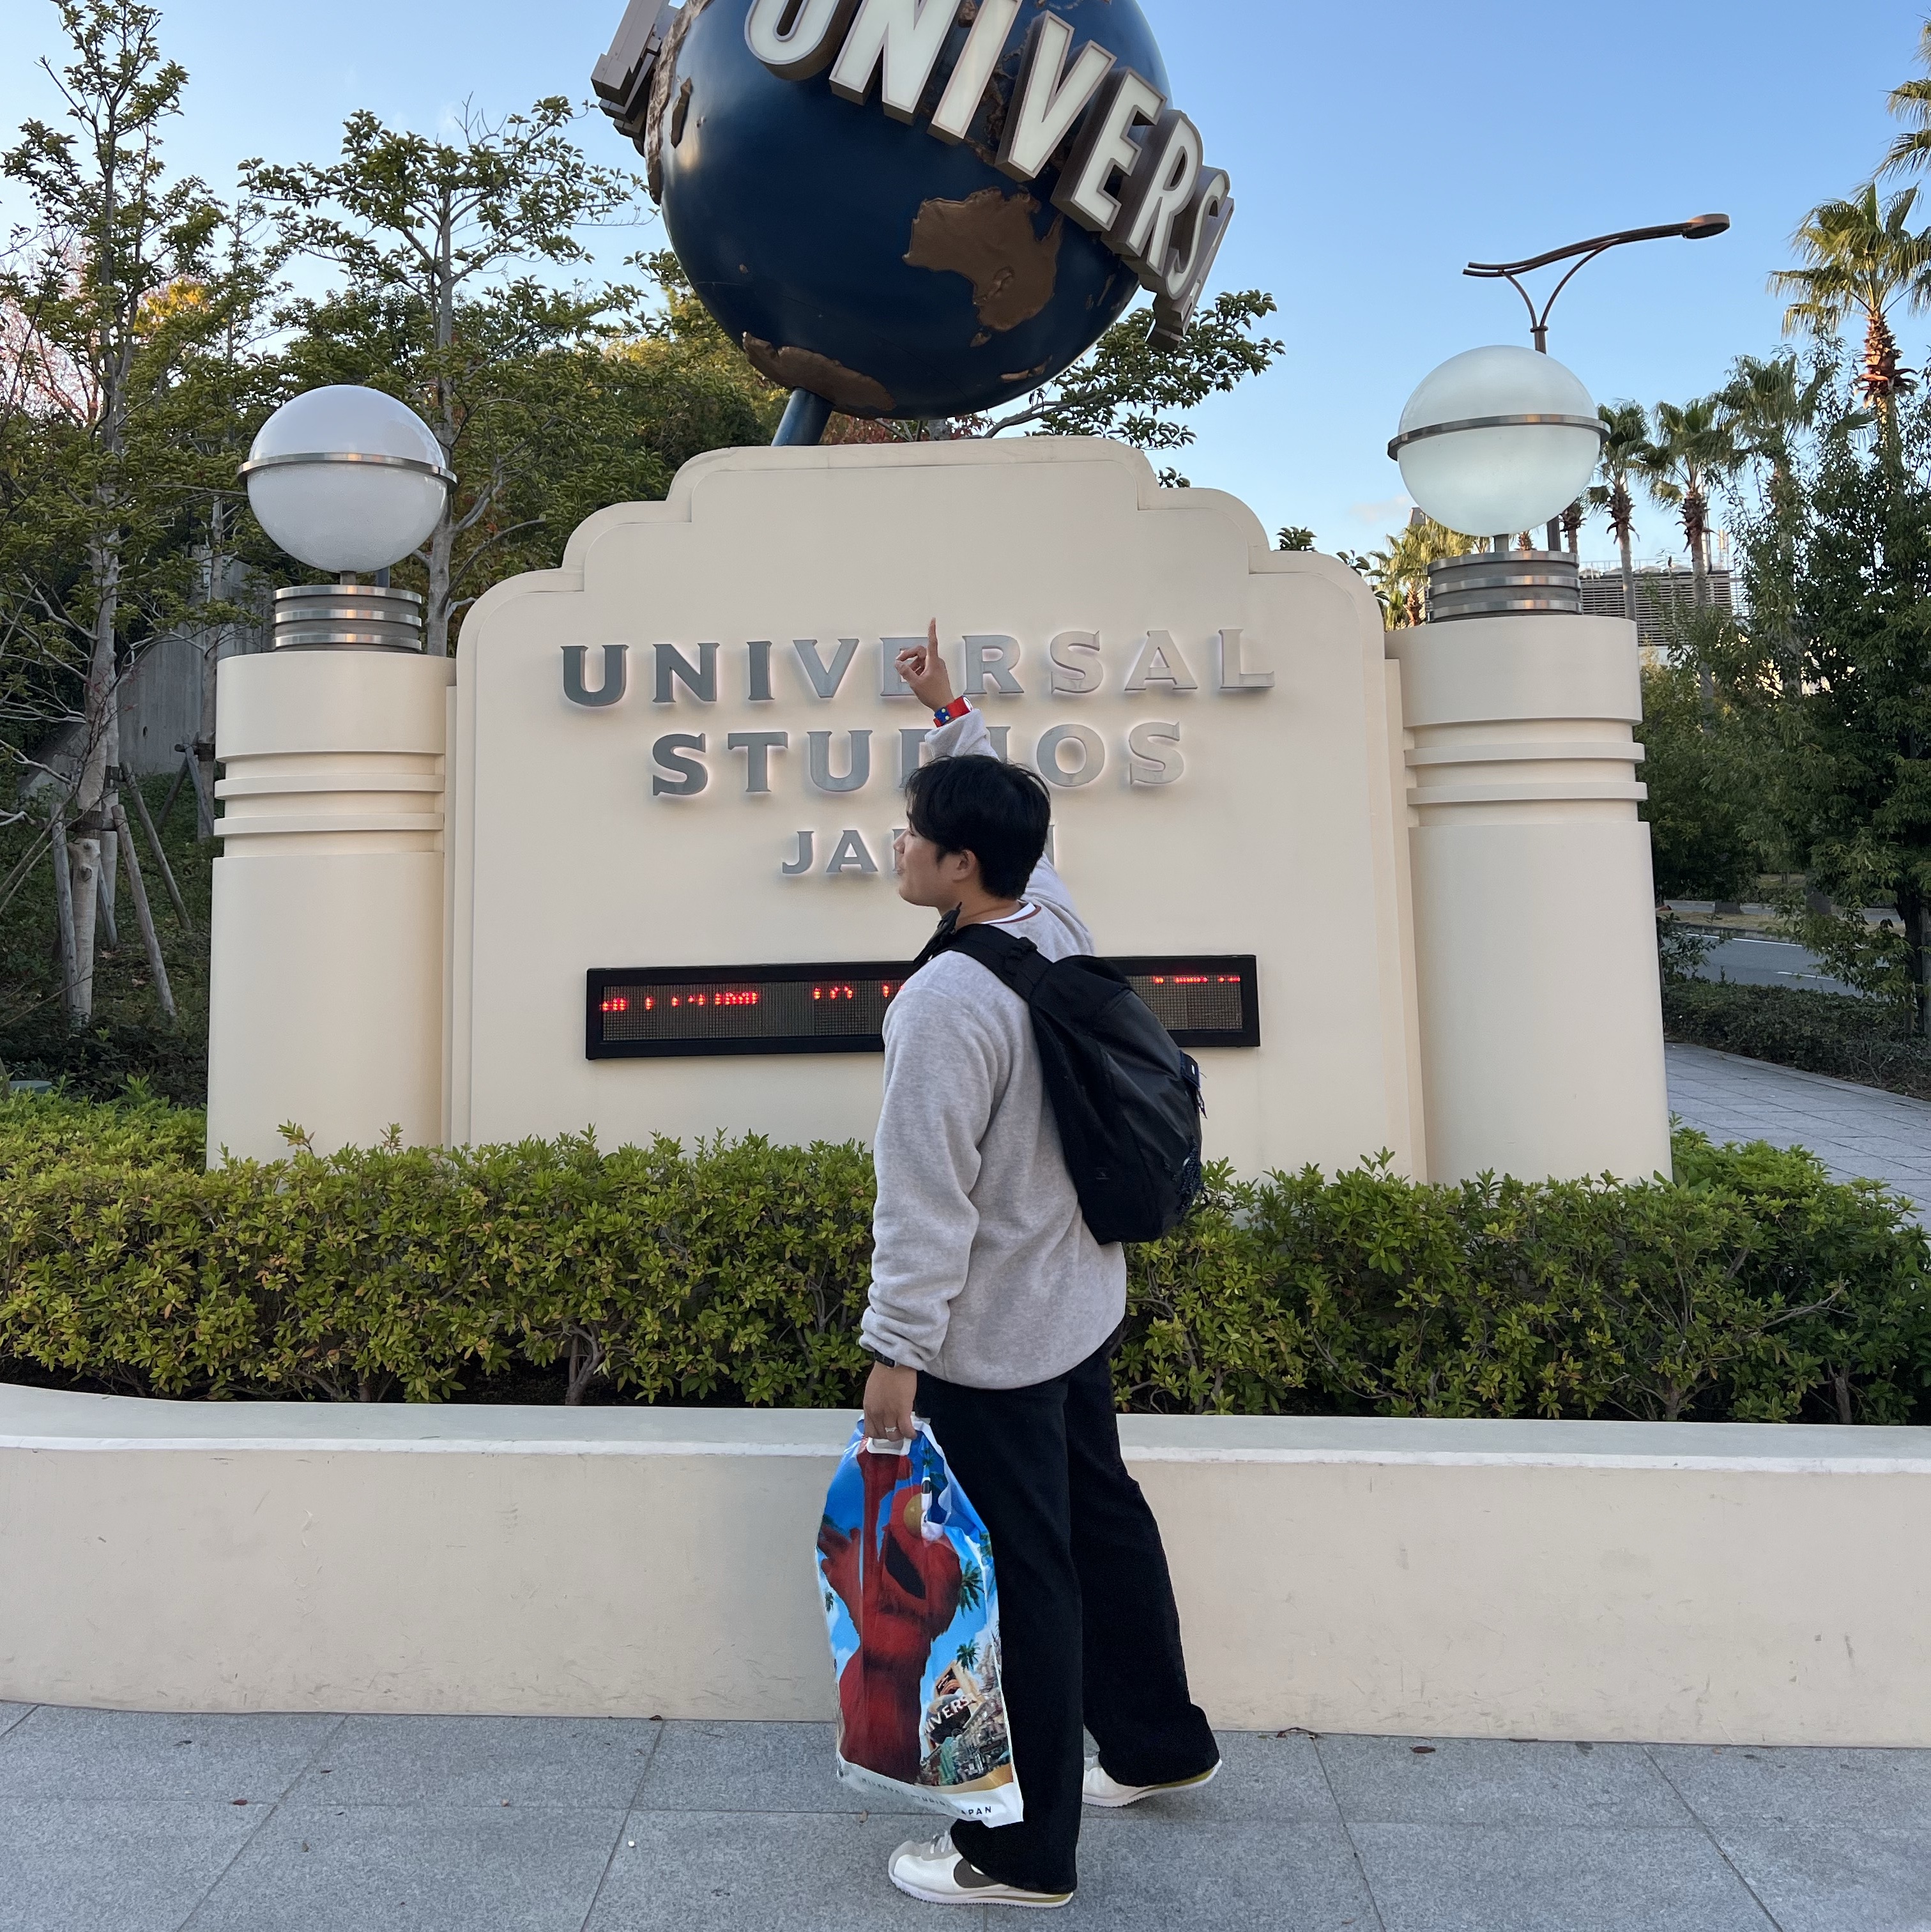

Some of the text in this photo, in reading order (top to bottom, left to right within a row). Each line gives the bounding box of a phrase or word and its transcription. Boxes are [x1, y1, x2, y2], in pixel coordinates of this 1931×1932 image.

[744, 0, 1234, 337] NIVERS
[560, 629, 1275, 707] UNIVERSAL
[924, 1693, 977, 1734] IVERS
[960, 1805, 992, 1816] PAN
